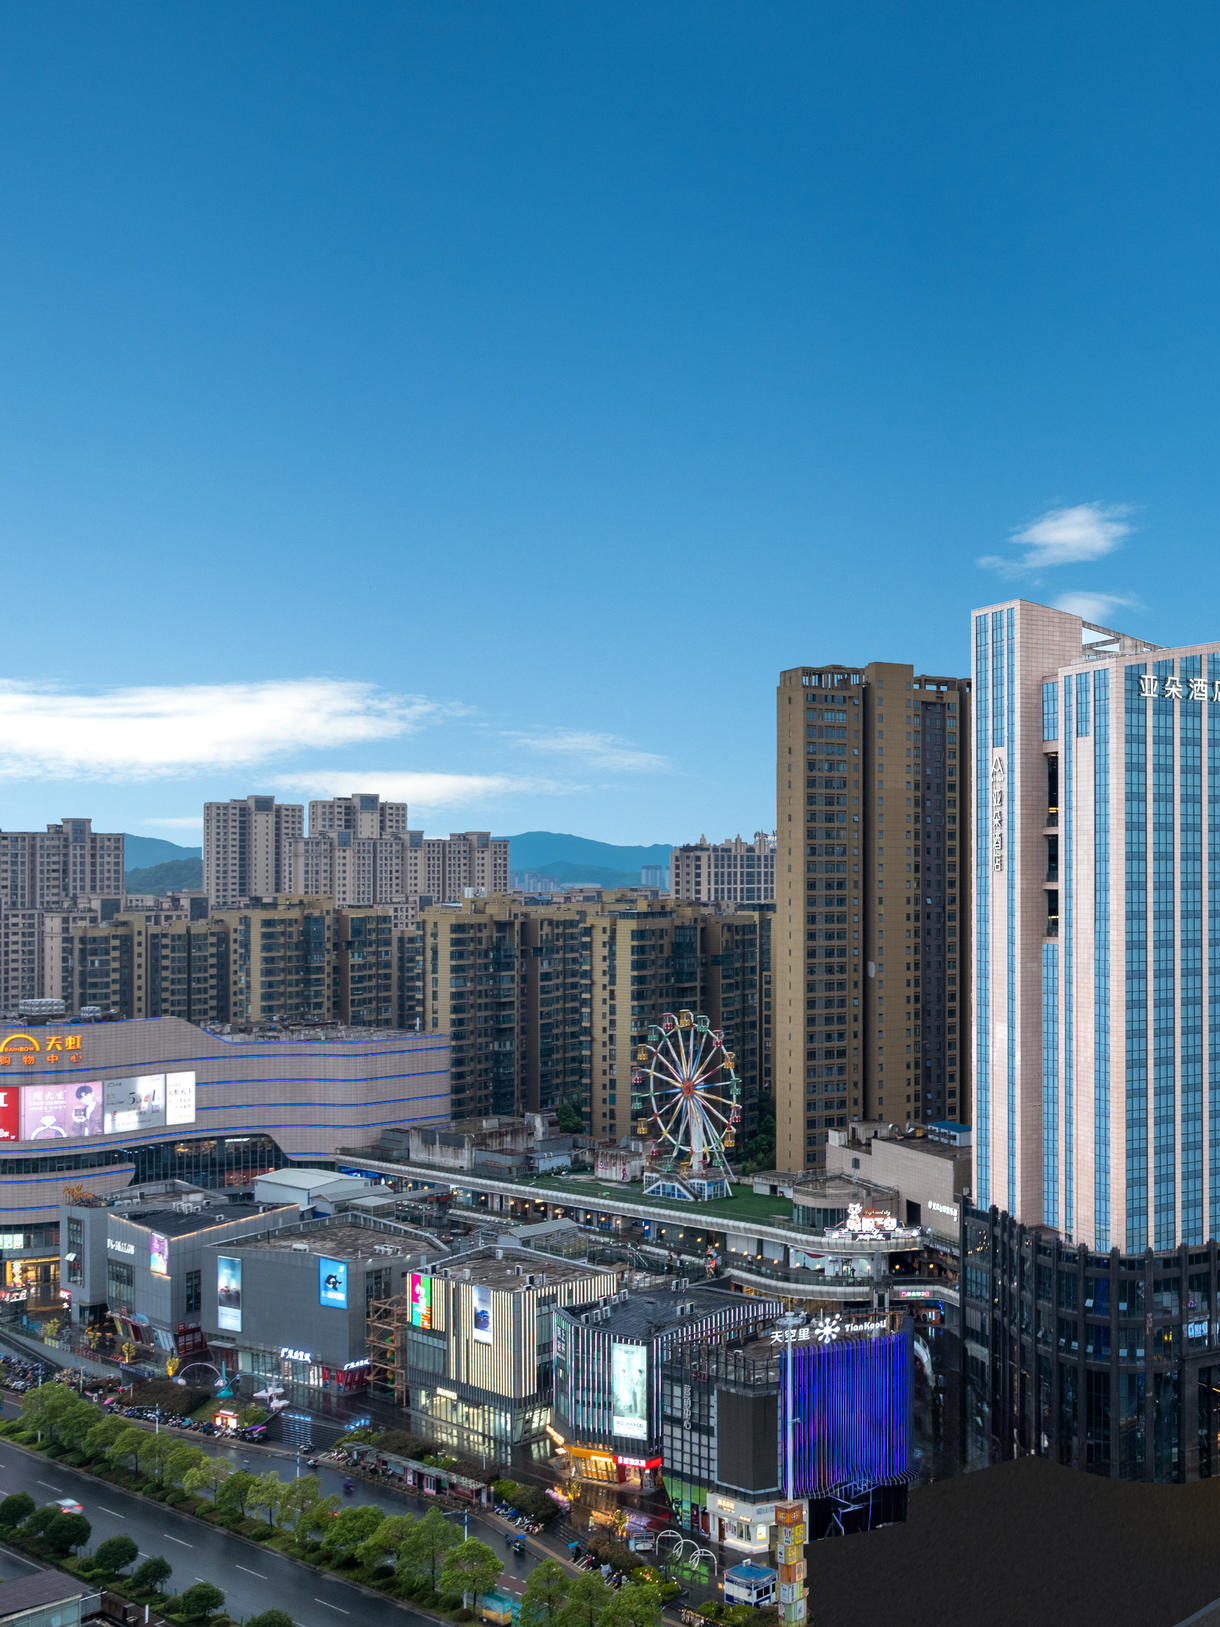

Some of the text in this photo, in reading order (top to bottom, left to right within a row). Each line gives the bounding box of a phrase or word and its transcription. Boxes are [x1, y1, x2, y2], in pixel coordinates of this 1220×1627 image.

[46, 1035, 83, 1051] 天虹
[0, 1052, 83, 1065] 购物中心
[770, 1327, 811, 1344] 天空里
